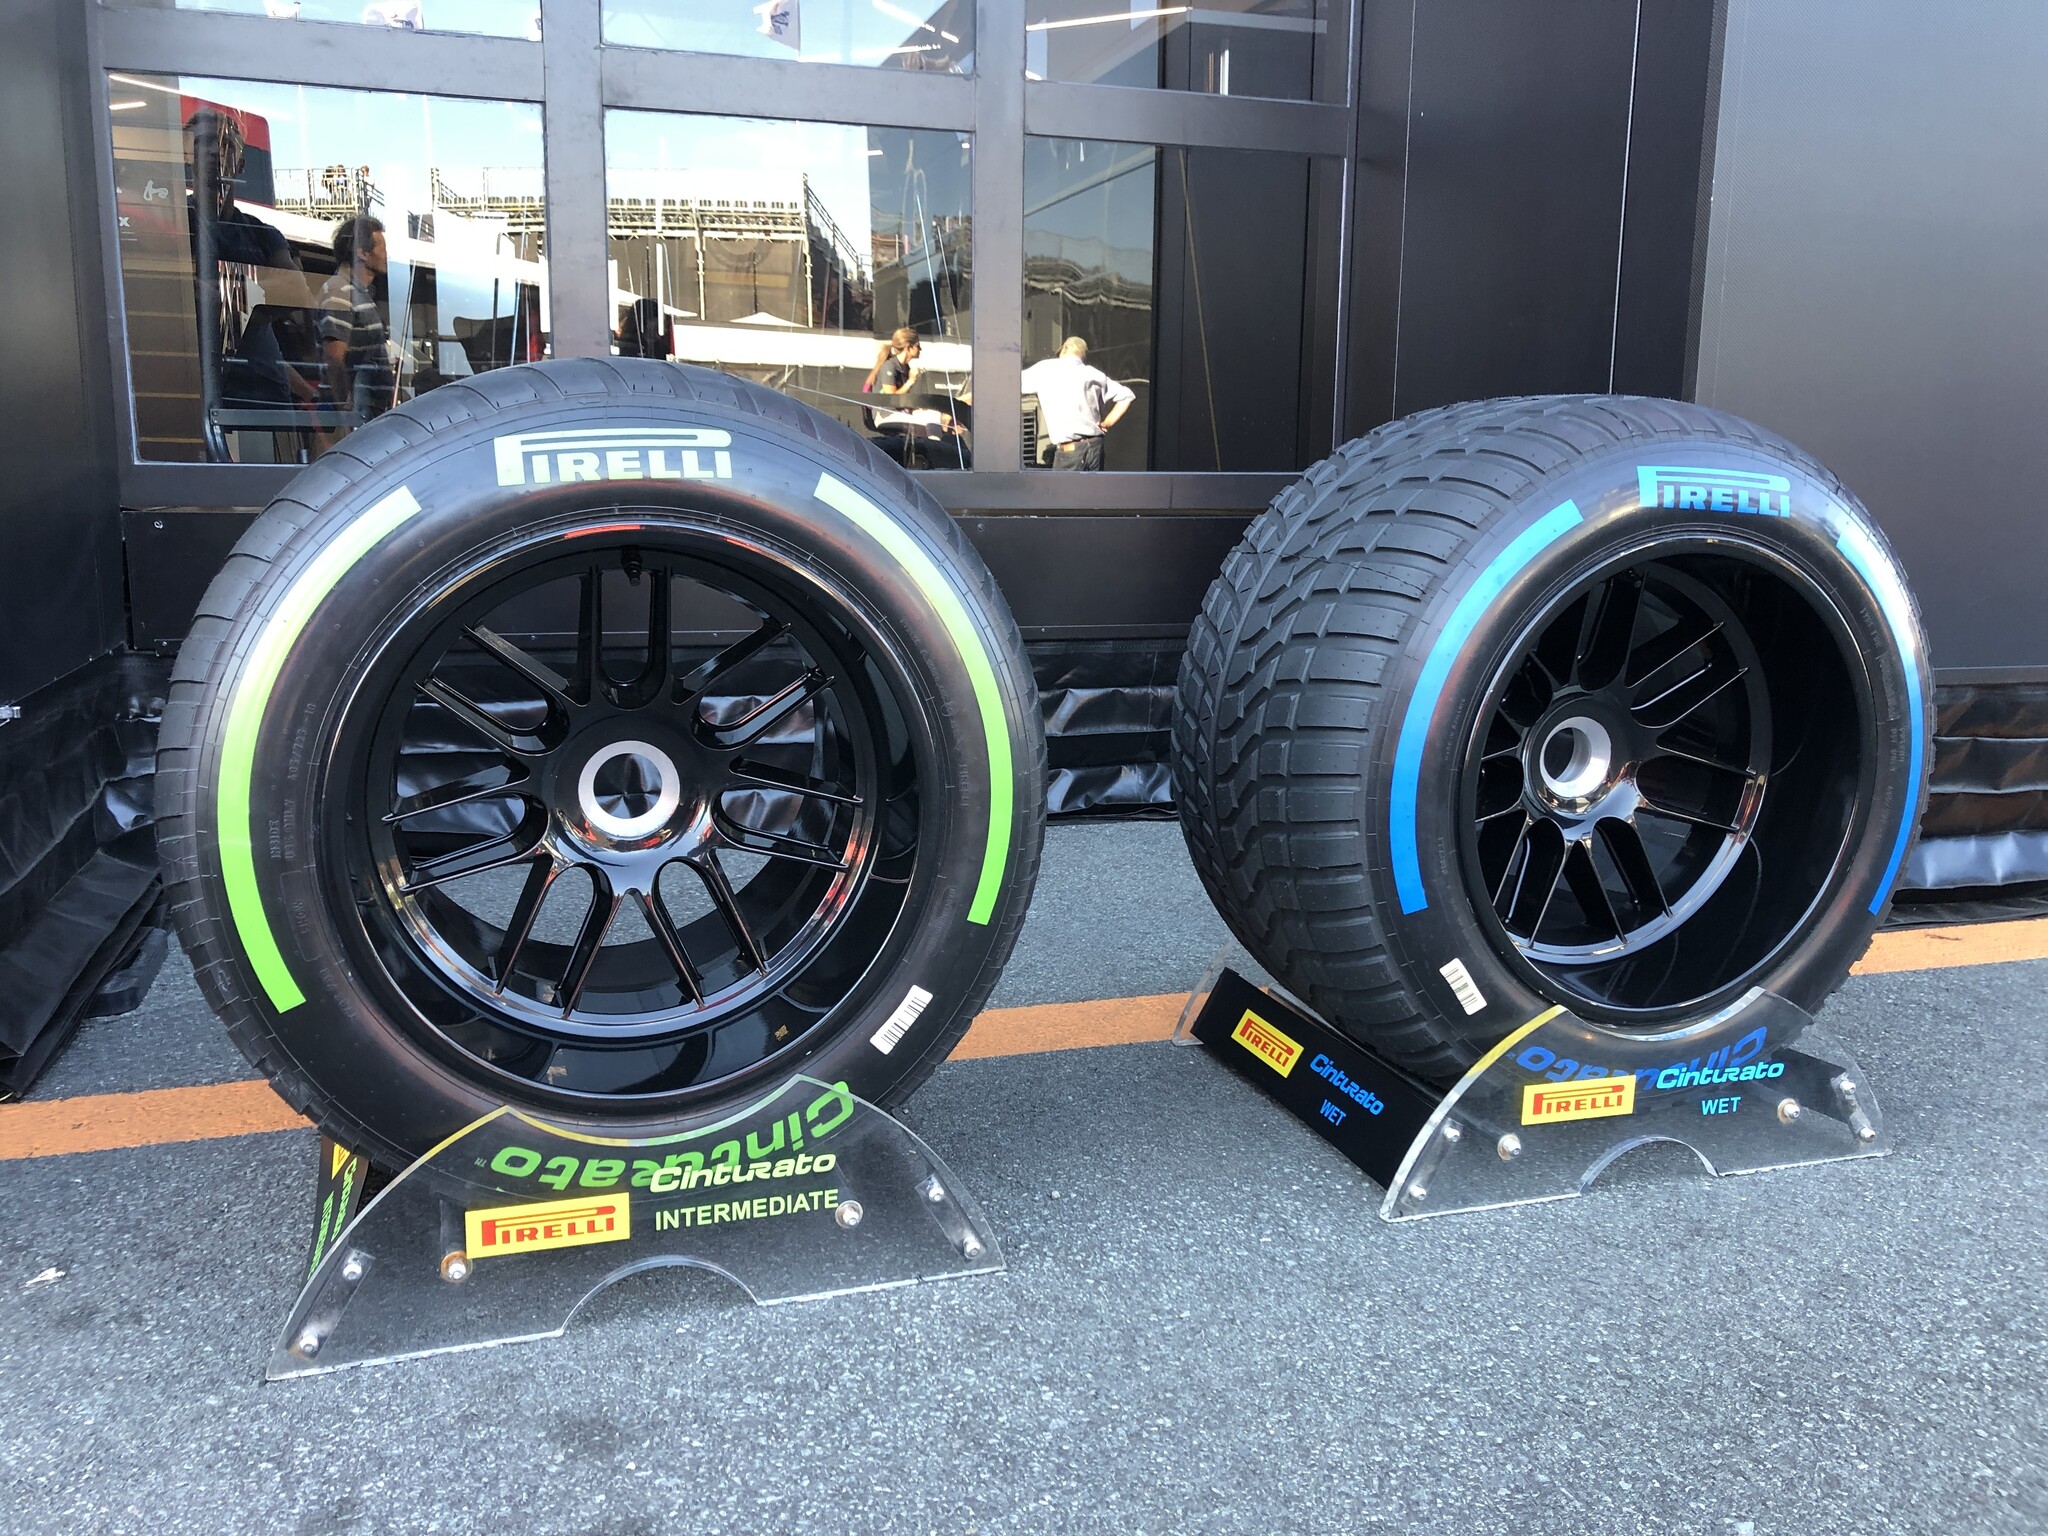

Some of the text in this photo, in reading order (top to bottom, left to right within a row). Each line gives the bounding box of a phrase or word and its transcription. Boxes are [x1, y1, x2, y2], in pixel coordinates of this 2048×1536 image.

[494, 428, 733, 487] PIRELLI
[1637, 465, 1791, 518] PIRELLI
[958, 763, 970, 807] PIRELLI
[1239, 1017, 1295, 1067] PIRELLI
[1309, 1053, 1385, 1116] Cinturato
[1656, 1061, 1785, 1089] Cinturato
[1319, 1099, 1347, 1127] WET
[1532, 1084, 1625, 1116] PIRELLI
[1701, 1096, 1741, 1116] WET
[650, 1153, 837, 1193] Cinturato
[481, 1205, 616, 1246] PIRELLI
[655, 1188, 839, 1231] INTERMEDIATE
